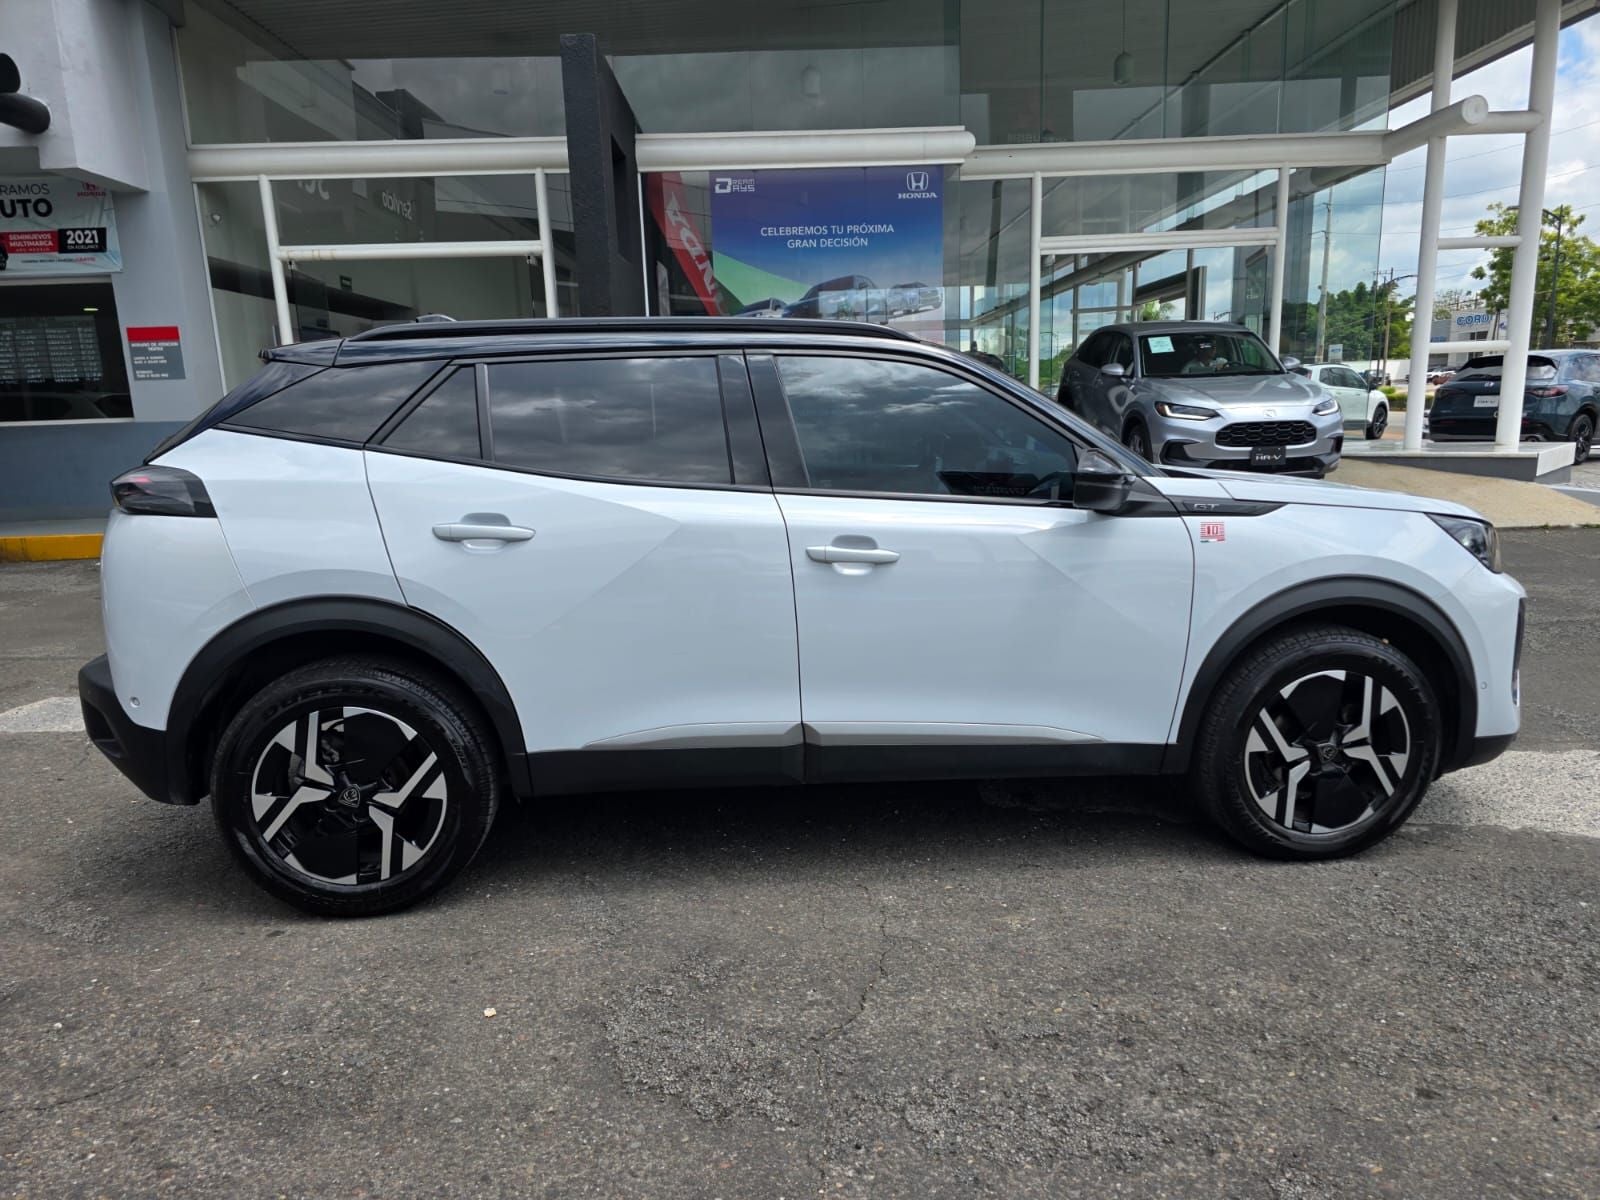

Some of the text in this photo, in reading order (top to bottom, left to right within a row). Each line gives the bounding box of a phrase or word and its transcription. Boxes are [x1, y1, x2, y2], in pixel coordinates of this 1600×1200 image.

[897, 191, 937, 199] HONDA
[760, 222, 894, 236] CELEBREMOS TU PRÓXIMA
[9, 233, 51, 241] SEMINUEVOS
[66, 230, 99, 244] 2021
[787, 236, 868, 248] GRAN DECISIÓN
[1193, 503, 1219, 511] GT
